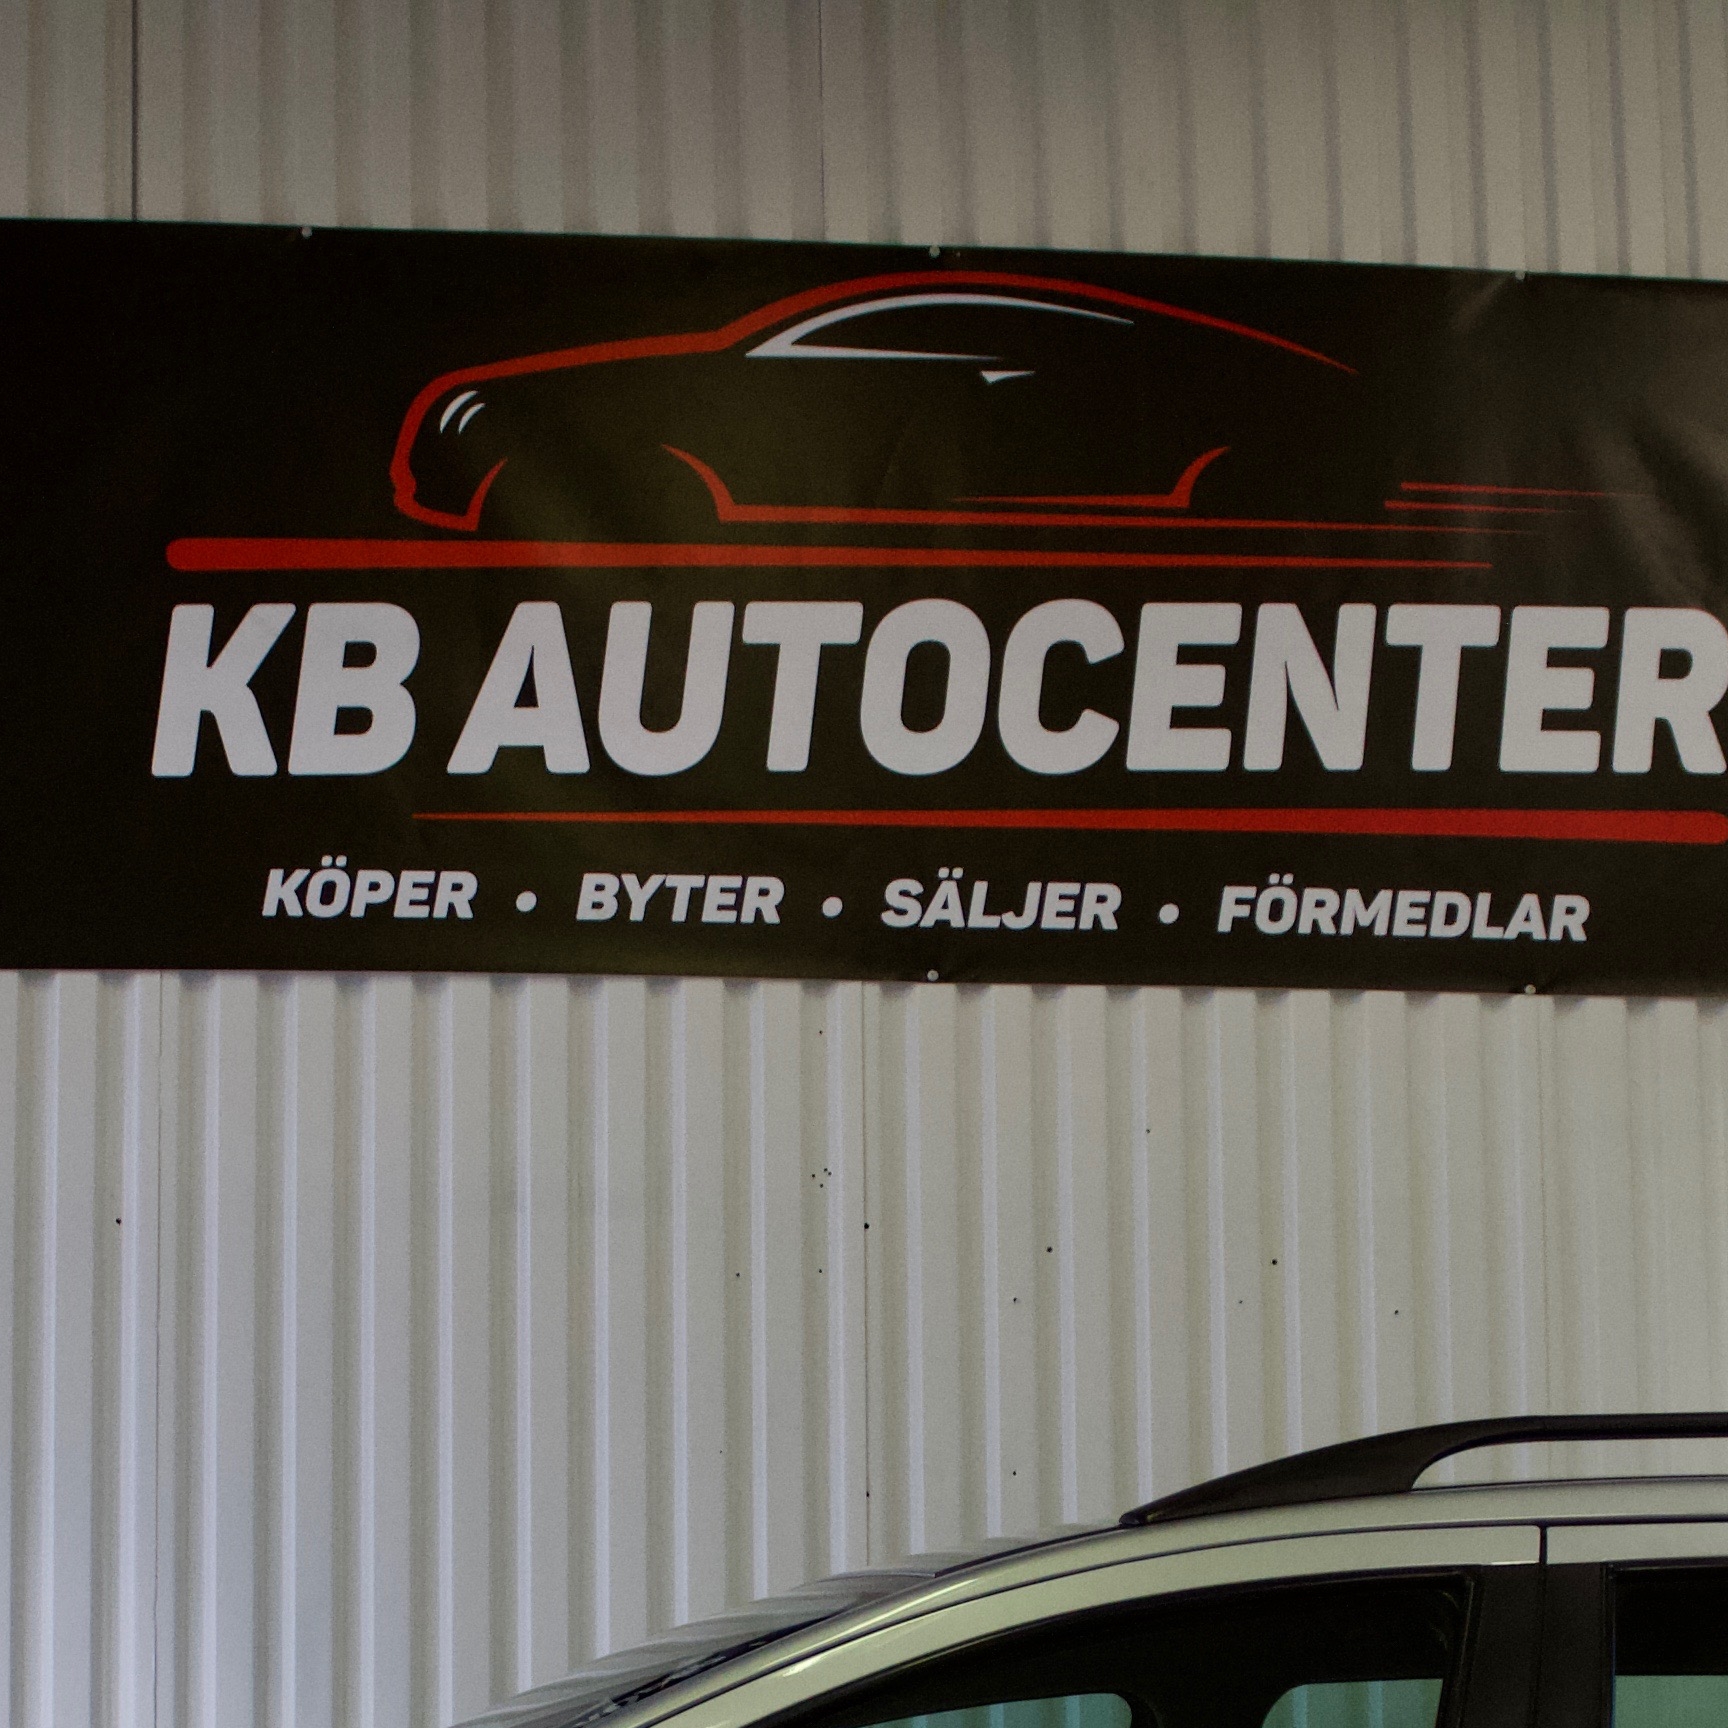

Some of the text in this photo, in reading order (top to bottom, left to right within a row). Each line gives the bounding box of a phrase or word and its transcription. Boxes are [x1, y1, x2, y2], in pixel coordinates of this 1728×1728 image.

[151, 602, 421, 777] KB
[261, 854, 1590, 942] KÖPER BYTER SÄLJER FÖRMEDLAR
